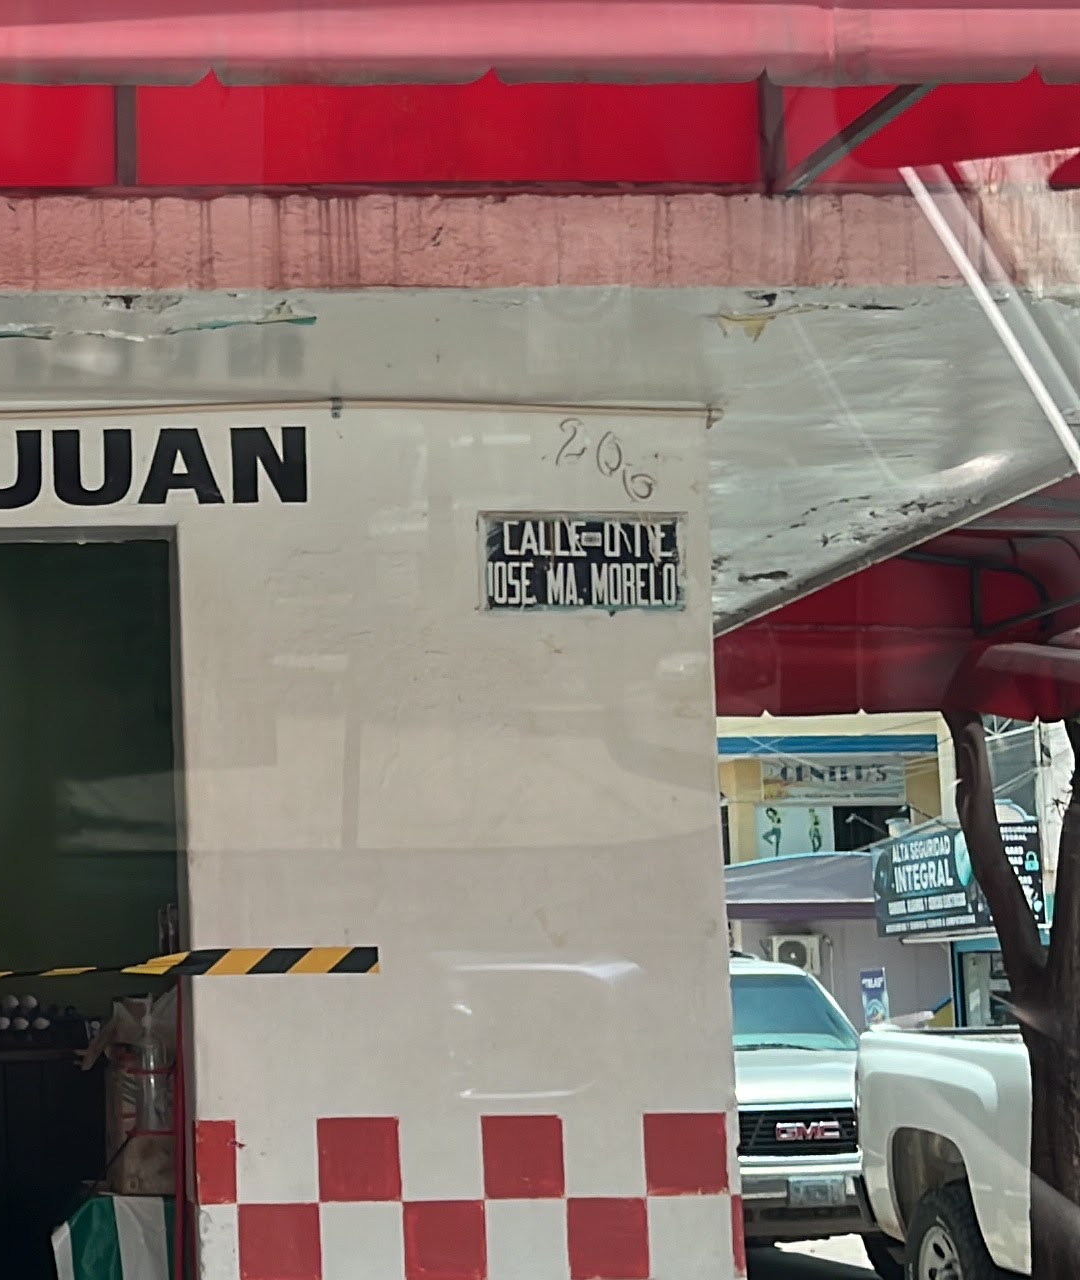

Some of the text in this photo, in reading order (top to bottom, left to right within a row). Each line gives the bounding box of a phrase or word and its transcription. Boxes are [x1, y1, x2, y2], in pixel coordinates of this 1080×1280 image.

[591, 562, 681, 607] MORELO
[892, 835, 951, 864] ALTA SEGURIDAD
[894, 858, 954, 894] INTEGRAL
[775, 1121, 840, 1141] GMC
